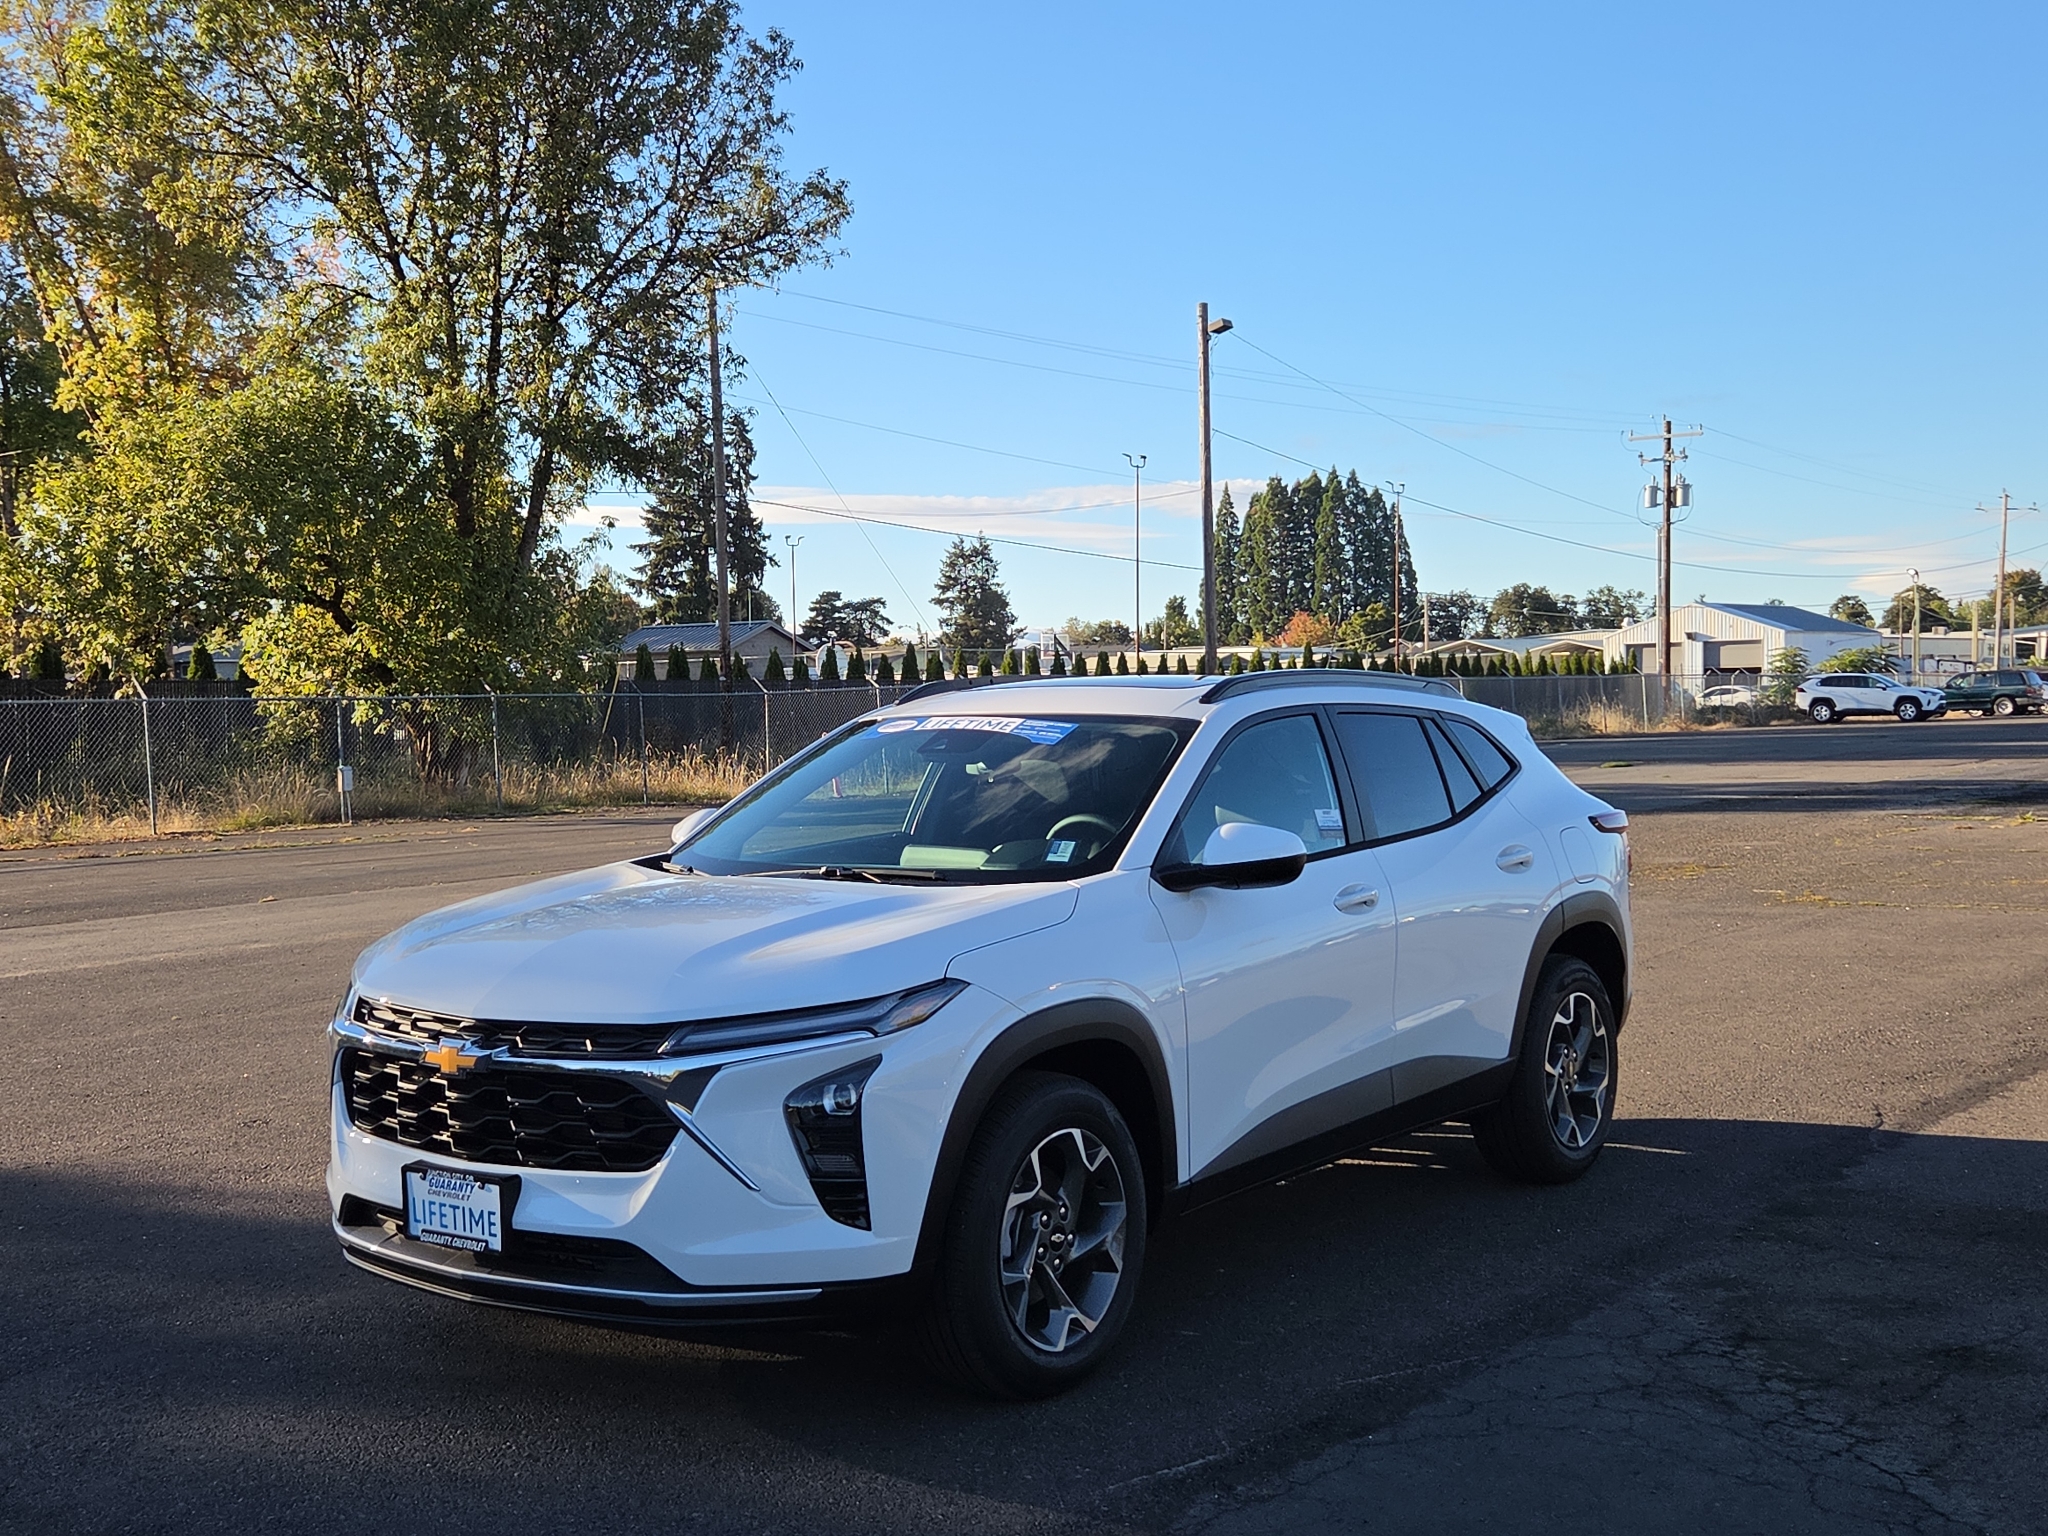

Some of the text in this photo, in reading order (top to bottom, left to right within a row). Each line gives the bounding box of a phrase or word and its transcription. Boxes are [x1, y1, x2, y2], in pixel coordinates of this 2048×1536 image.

[920, 718, 1017, 731] LIFETIME
[428, 1176, 476, 1194] GUARANTY
[427, 1188, 471, 1202] CHEVROLET
[412, 1197, 498, 1238] LIFETIME
[452, 1237, 486, 1252] CHEVROLET
